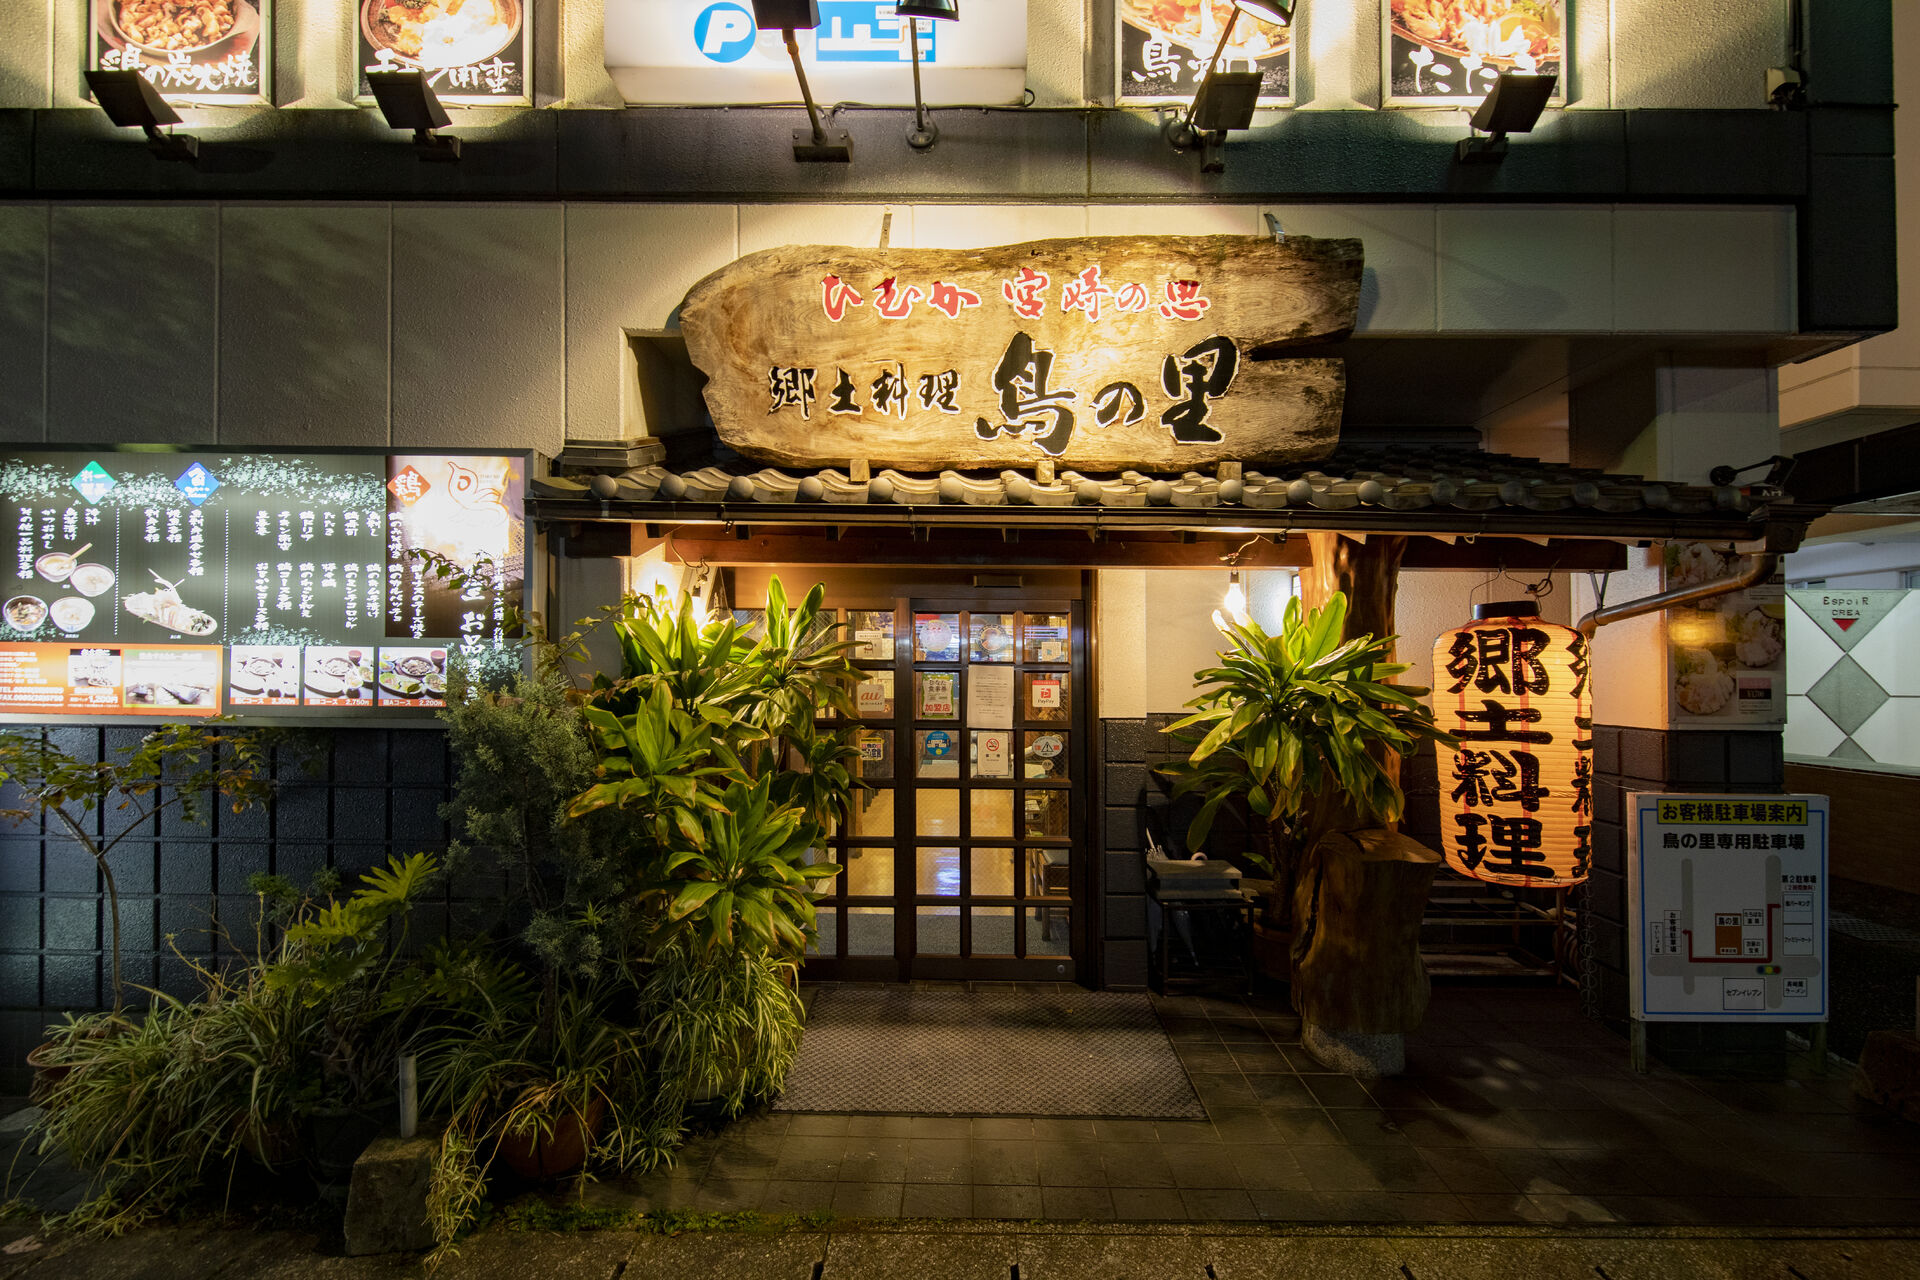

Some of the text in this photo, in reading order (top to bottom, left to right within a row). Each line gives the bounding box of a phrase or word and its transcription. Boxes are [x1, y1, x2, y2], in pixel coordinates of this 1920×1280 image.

[703, 10, 751, 53] P
[365, 48, 515, 93] チン南蛮
[822, 273, 981, 321] ひむか
[767, 331, 1240, 455] 郷土料理 鳥の里
[394, 470, 422, 497] 鶏
[277, 511, 293, 551] チキン南蛮
[860, 692, 880, 701] au
[925, 704, 951, 712] 加盟店
[1446, 628, 1555, 878] 郷土料理
[1662, 803, 1802, 822] お客様駐車場案内
[1663, 833, 1806, 850] 鳥の里専用駐車場
[1719, 917, 1739, 926] 鳥の里
